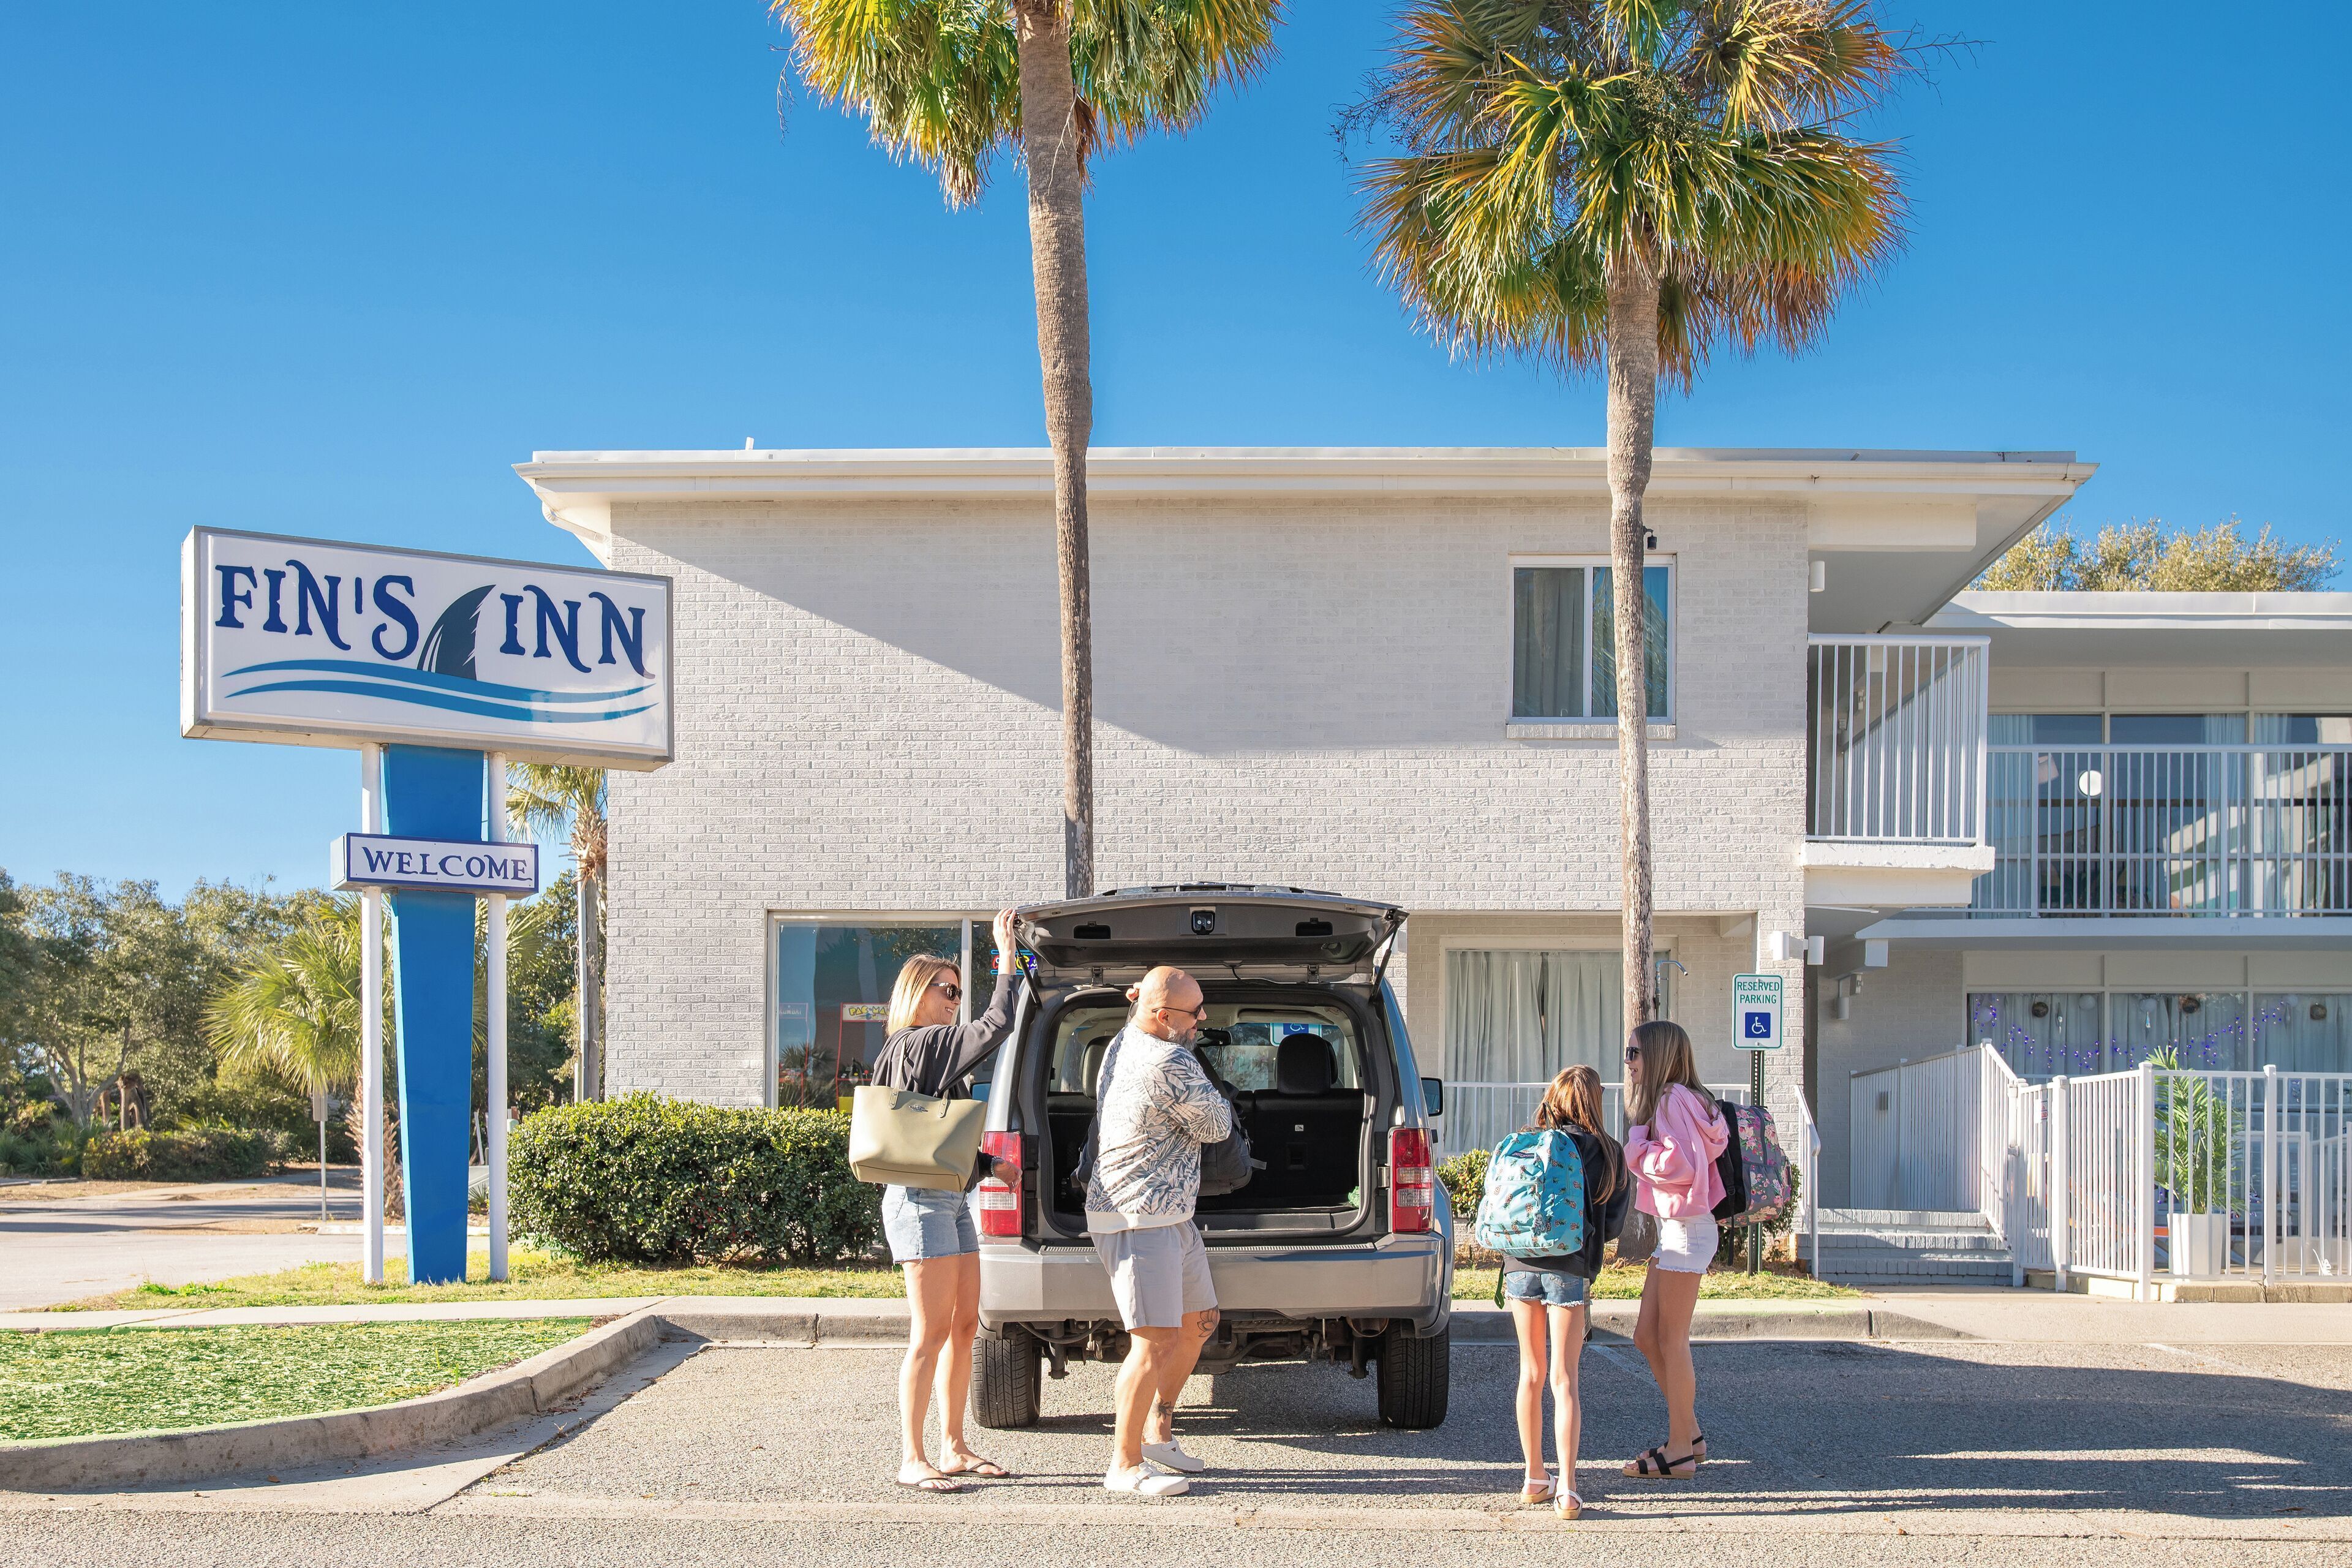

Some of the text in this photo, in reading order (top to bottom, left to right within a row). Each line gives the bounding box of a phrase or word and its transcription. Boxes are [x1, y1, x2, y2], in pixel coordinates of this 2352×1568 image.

[215, 559, 656, 679] FIN'S INN
[361, 846, 533, 881] WELCOME
[1737, 981, 1780, 991] RESERVED
[1740, 994, 1777, 1004] PARKING
[848, 1005, 889, 1016] PAC-MA
